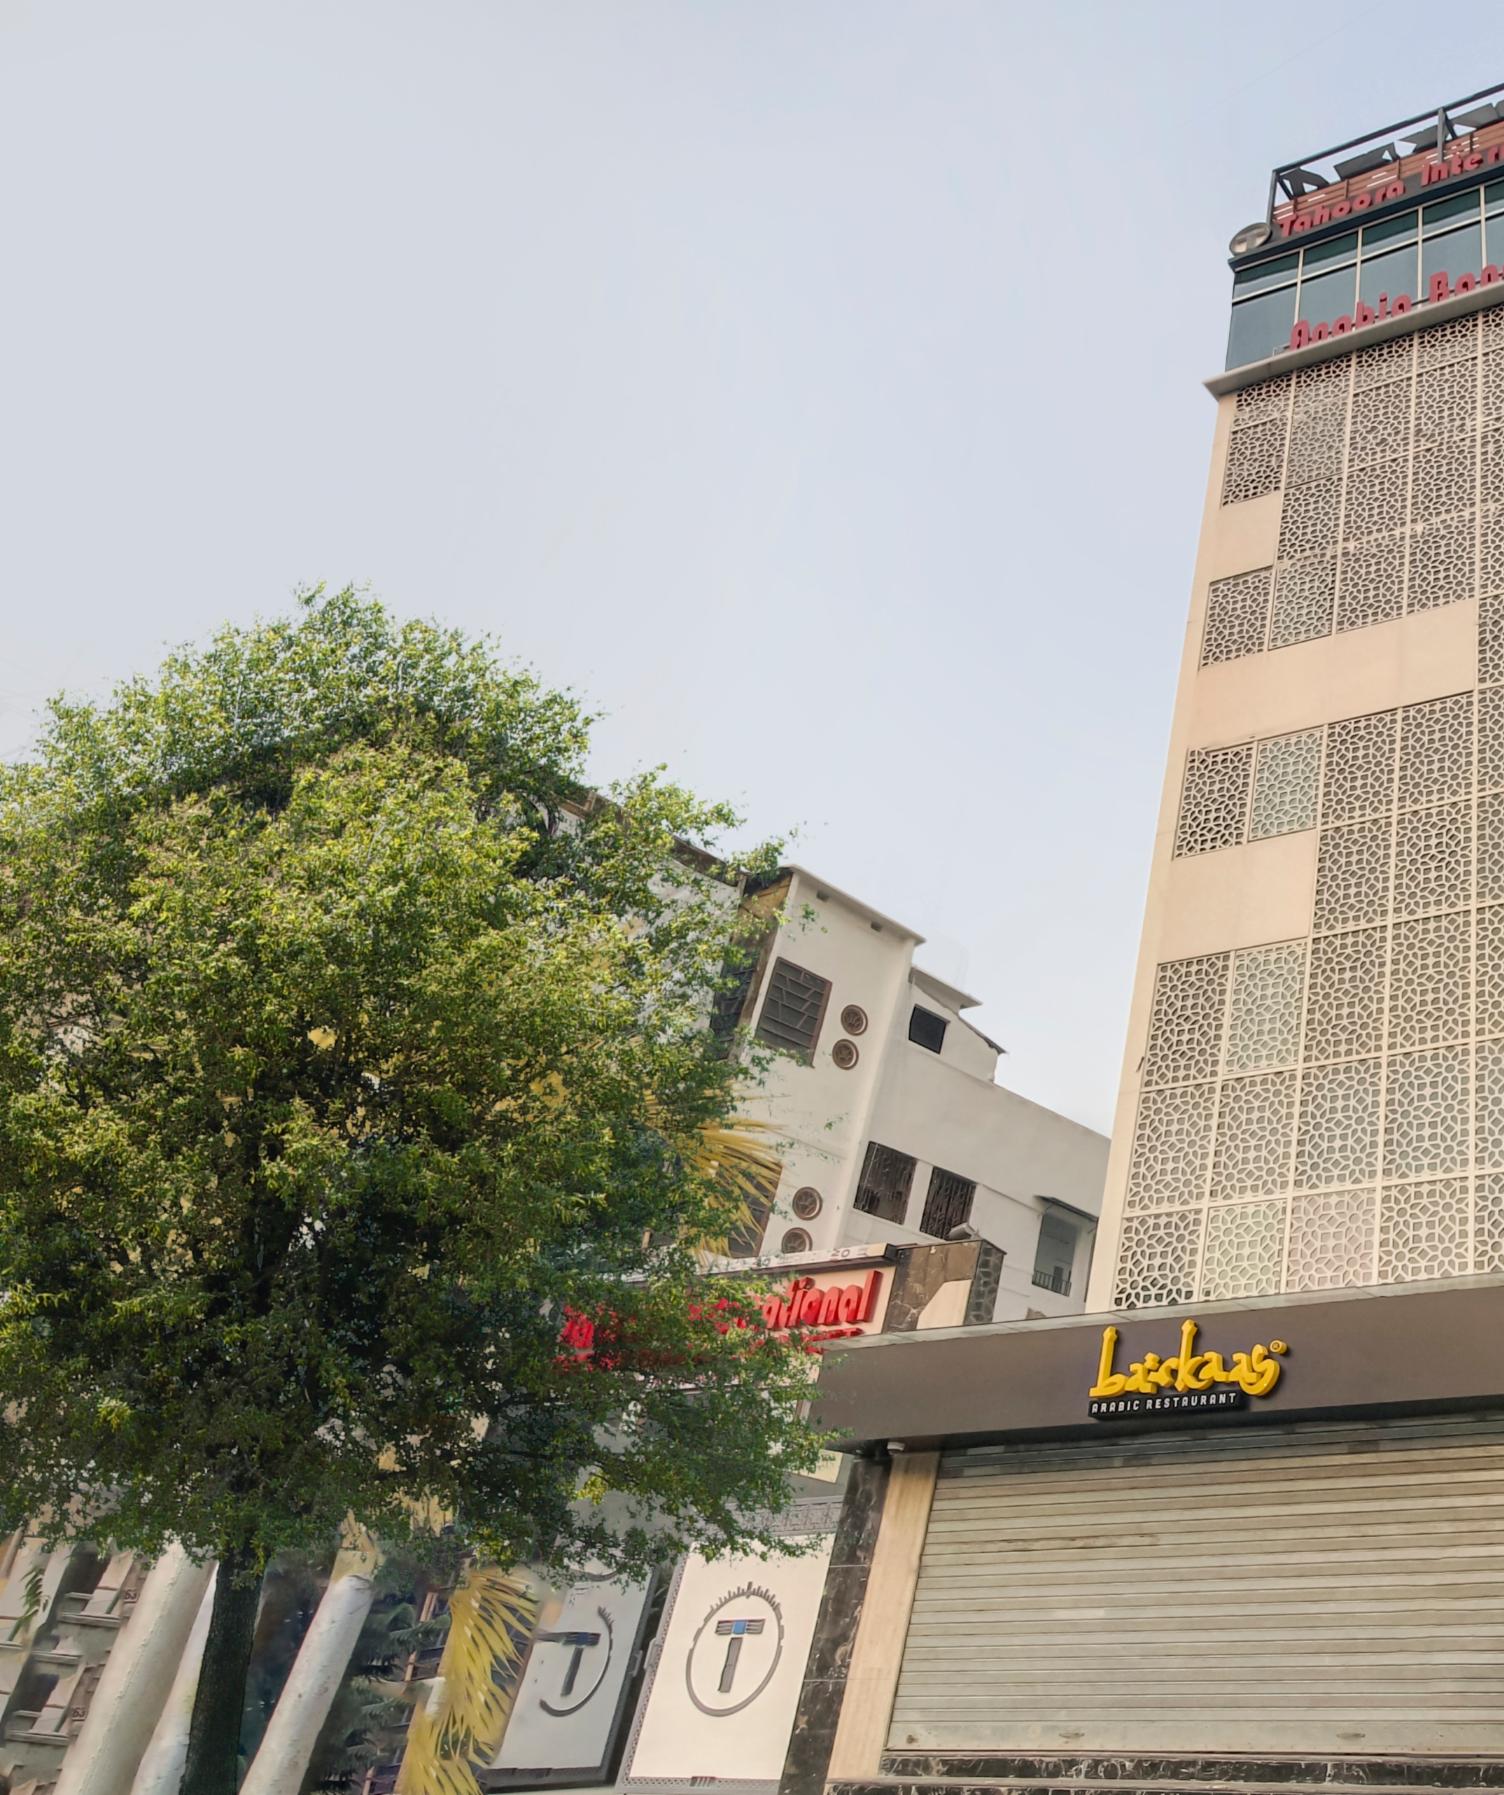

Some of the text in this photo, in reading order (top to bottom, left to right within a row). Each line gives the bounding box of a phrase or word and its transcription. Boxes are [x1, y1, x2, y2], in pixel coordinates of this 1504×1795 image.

[1276, 179, 1406, 237] Tahoora
[1091, 1392, 1237, 1414] ARABIC RESTAURANT
